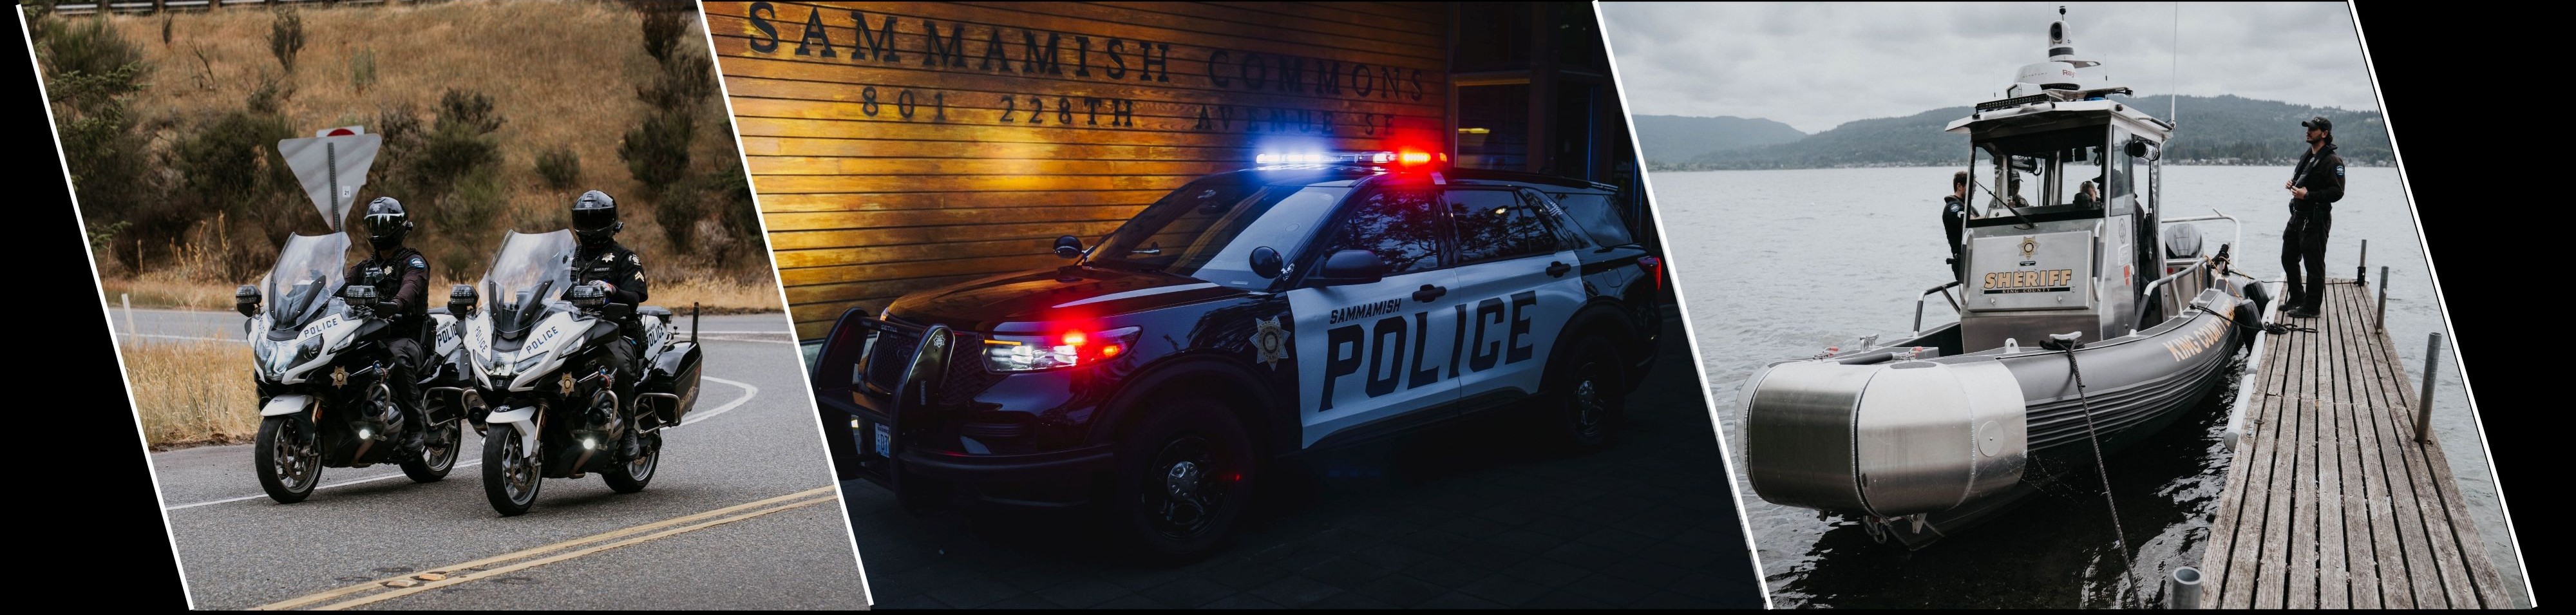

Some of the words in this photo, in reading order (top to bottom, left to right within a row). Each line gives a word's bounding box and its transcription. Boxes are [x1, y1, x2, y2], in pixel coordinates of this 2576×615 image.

[748, 1, 1170, 83] SAMMAMISH
[1208, 50, 1423, 102] COMMONS
[862, 86, 945, 121] 801
[999, 97, 1133, 127] 228TH
[1195, 104, 1335, 135] AVENUE
[1365, 113, 1396, 136] SE
[1984, 269, 2072, 289] SHERIFF
[1329, 298, 1402, 324] SAMMAMISH
[303, 318, 338, 337] POLICE
[437, 321, 459, 348] POLIC
[475, 326, 488, 353] POLICE
[526, 326, 558, 354] POLICE
[647, 323, 665, 348] OLICE
[1318, 290, 1538, 413] POLICE
[2163, 334, 2202, 362] KING
